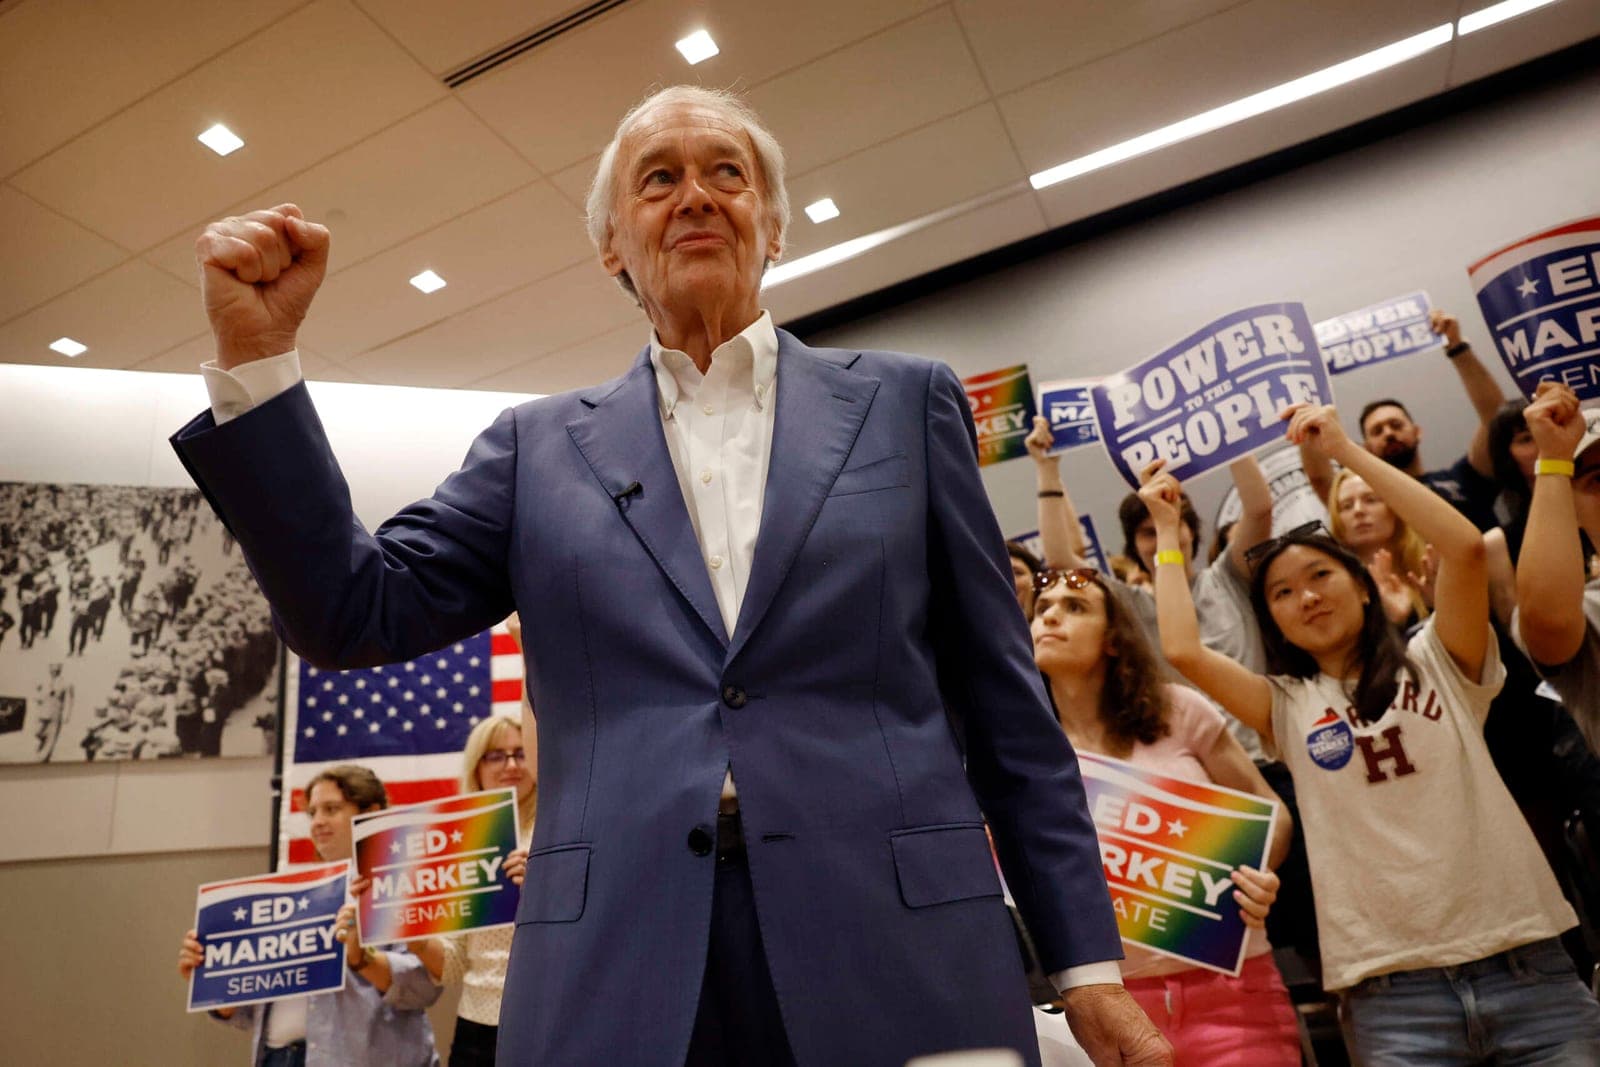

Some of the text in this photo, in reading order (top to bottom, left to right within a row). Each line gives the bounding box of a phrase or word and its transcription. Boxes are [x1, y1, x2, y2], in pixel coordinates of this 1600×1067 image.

[1547, 252, 1600, 296] E
[1106, 314, 1305, 430] POWER
[1184, 380, 1233, 412] TO THE
[1355, 725, 1416, 783] H
[1093, 793, 1161, 835] ED
[405, 829, 448, 858] ED
[372, 856, 503, 900] MARKEY
[250, 896, 294, 926] ED
[395, 899, 472, 926] SENATE
[204, 924, 338, 969] MARKEY
[227, 967, 308, 996] SENATE
